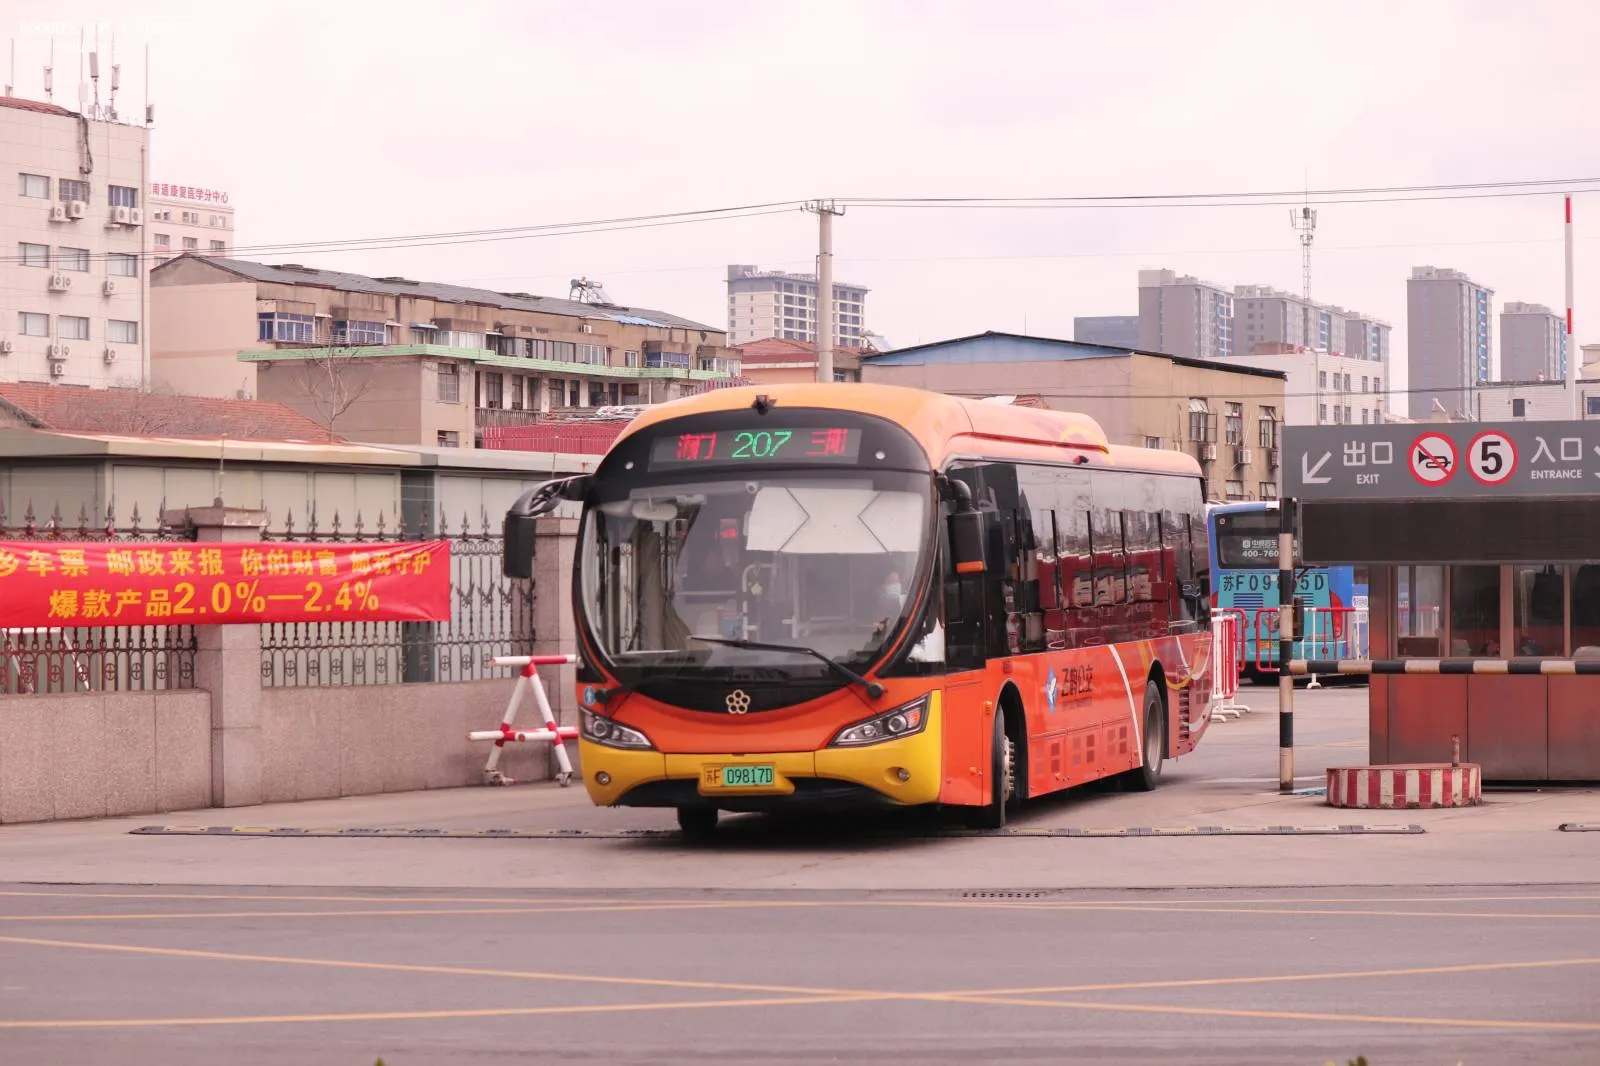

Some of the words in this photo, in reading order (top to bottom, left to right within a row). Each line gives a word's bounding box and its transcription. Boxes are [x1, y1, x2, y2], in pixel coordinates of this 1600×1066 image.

[732, 431, 792, 459] 207
[1343, 440, 1393, 466] 出口
[1481, 441, 1503, 475] 5
[1530, 436, 1582, 463] 入口
[1356, 473, 1380, 485] EXIT
[1531, 469, 1582, 480] ENTRANCE
[107, 548, 224, 577] 邮政来报
[240, 548, 341, 577] 你的财富
[1223, 574, 1325, 591] 苏F095D
